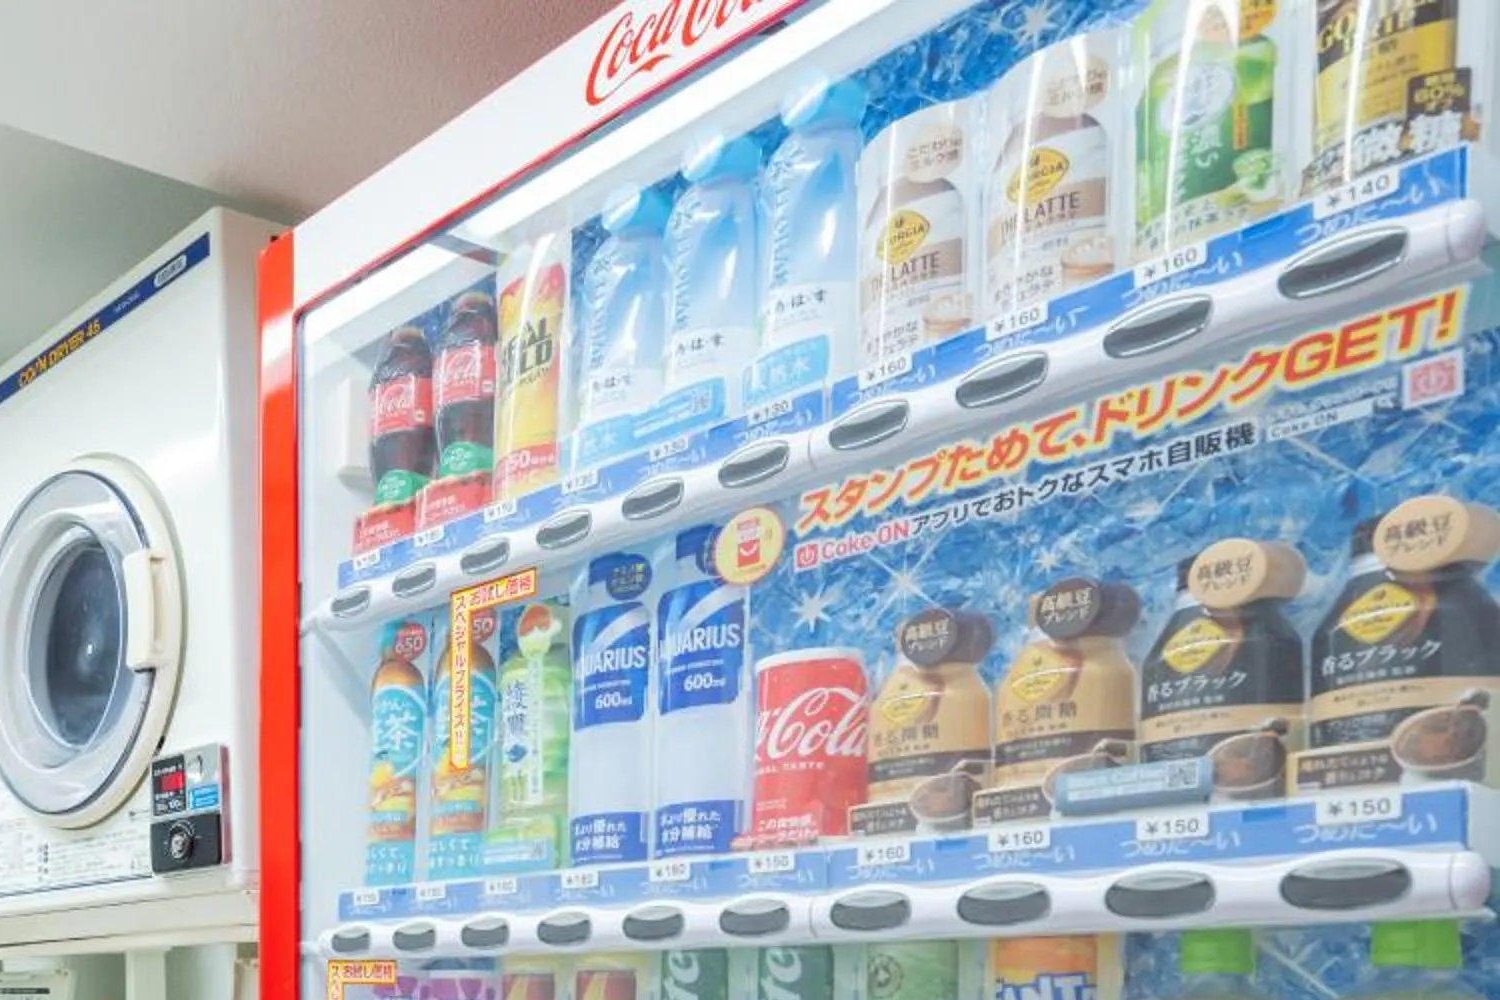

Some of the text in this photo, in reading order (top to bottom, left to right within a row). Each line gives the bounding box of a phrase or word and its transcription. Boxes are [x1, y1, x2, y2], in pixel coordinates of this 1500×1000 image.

[1326, 174, 1391, 207] ¥140
[1024, 190, 1082, 224] LATTE
[1143, 246, 1198, 278] ¥160
[993, 306, 1041, 333] ¥160
[866, 356, 907, 382] ¥160
[1327, 798, 1392, 818] ¥150
[997, 830, 1044, 847] ¥160
[1145, 817, 1200, 836] ¥150
[865, 845, 905, 862] ¥160
